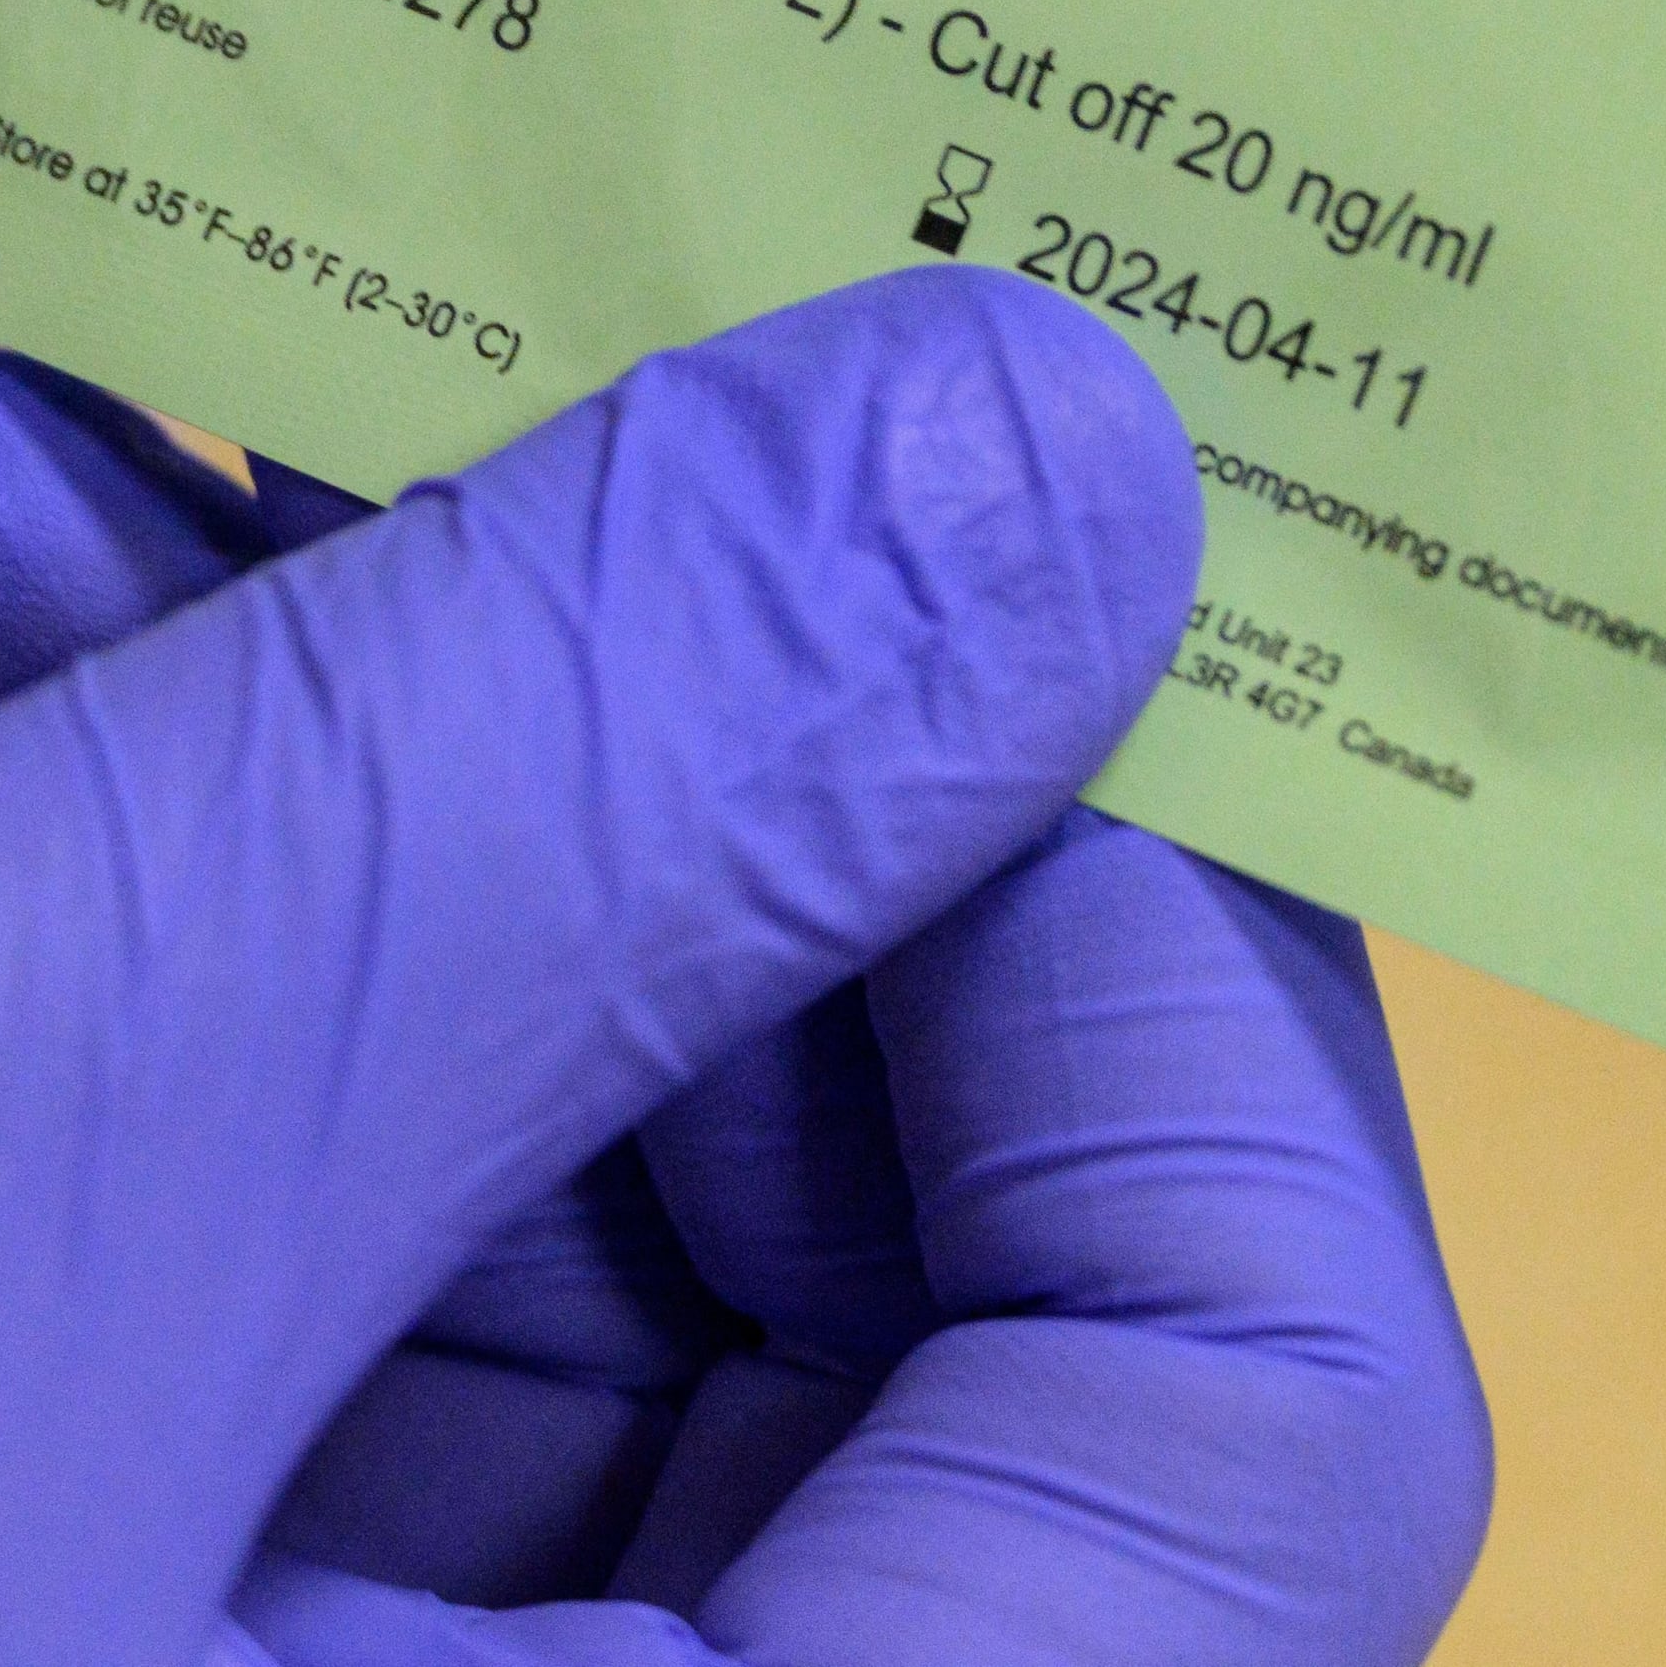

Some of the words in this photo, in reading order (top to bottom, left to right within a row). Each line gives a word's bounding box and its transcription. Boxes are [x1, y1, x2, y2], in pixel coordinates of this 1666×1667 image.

[83, 165, 128, 203] at
[880, 14, 905, 34] -
[928, 8, 1055, 112] Cut
[1070, 82, 1176, 153] off
[1176, 110, 1274, 198] 20
[1286, 162, 1497, 289] ng/ml
[1018, 213, 1428, 430] 2024-04-11
[1194, 442, 1448, 579] companying
[1217, 609, 1290, 665] Unit
[1294, 642, 1344, 686] 23
[1246, 680, 1325, 730] 4G7
[1339, 717, 1476, 801] Canada
